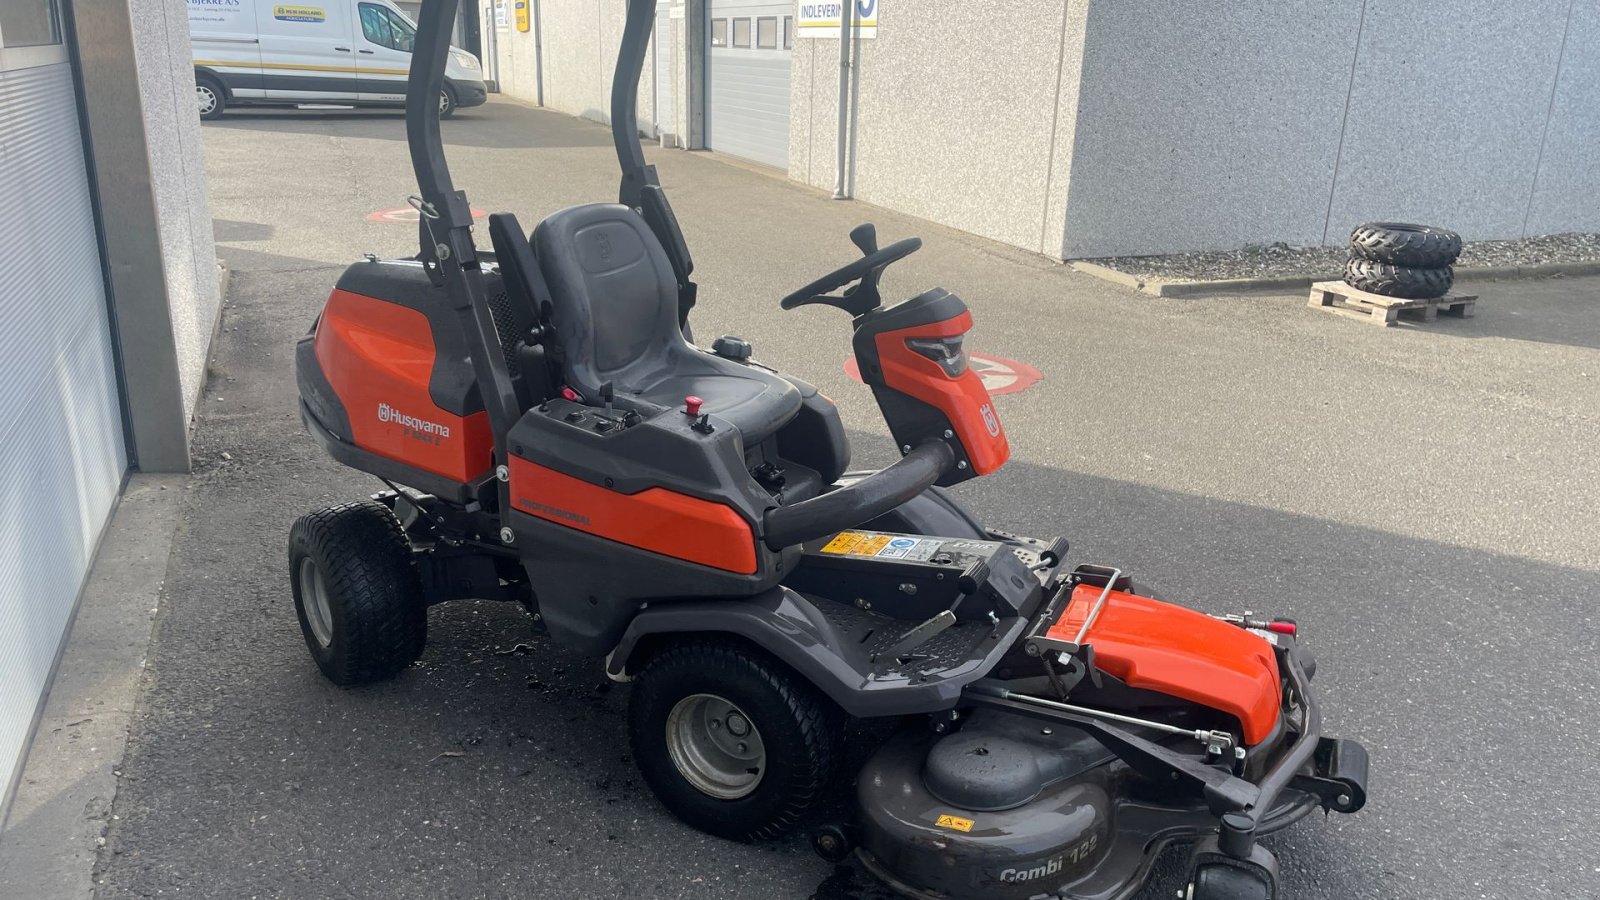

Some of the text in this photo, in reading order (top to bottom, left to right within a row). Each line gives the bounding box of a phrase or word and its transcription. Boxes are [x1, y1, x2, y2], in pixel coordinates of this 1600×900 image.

[390, 408, 450, 438] Husqvarna
[519, 497, 592, 527] PROFESSIONAL
[1000, 834, 1098, 883] Combi 122
